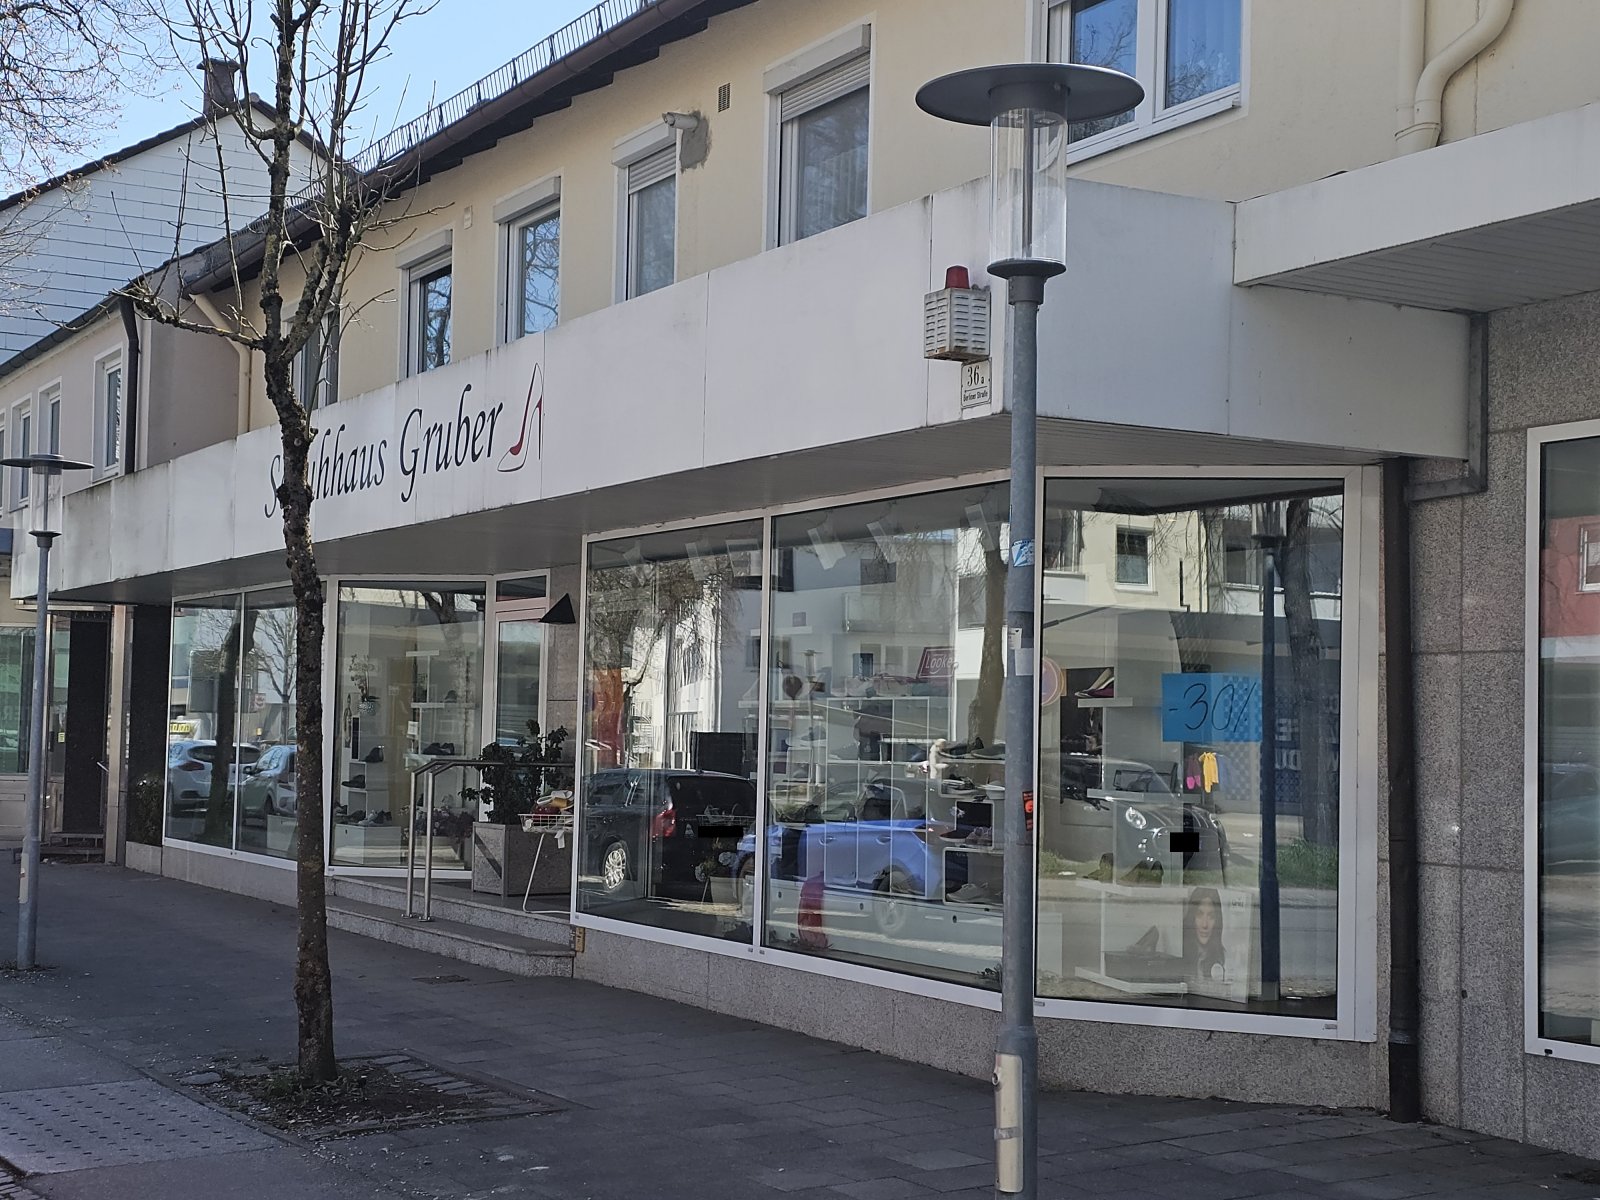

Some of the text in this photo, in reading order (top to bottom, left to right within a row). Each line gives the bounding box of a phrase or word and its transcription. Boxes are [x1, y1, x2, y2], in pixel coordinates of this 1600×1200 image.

[264, 383, 504, 519] Shhaus Gruber
[1168, 682, 1257, 733] -30%
